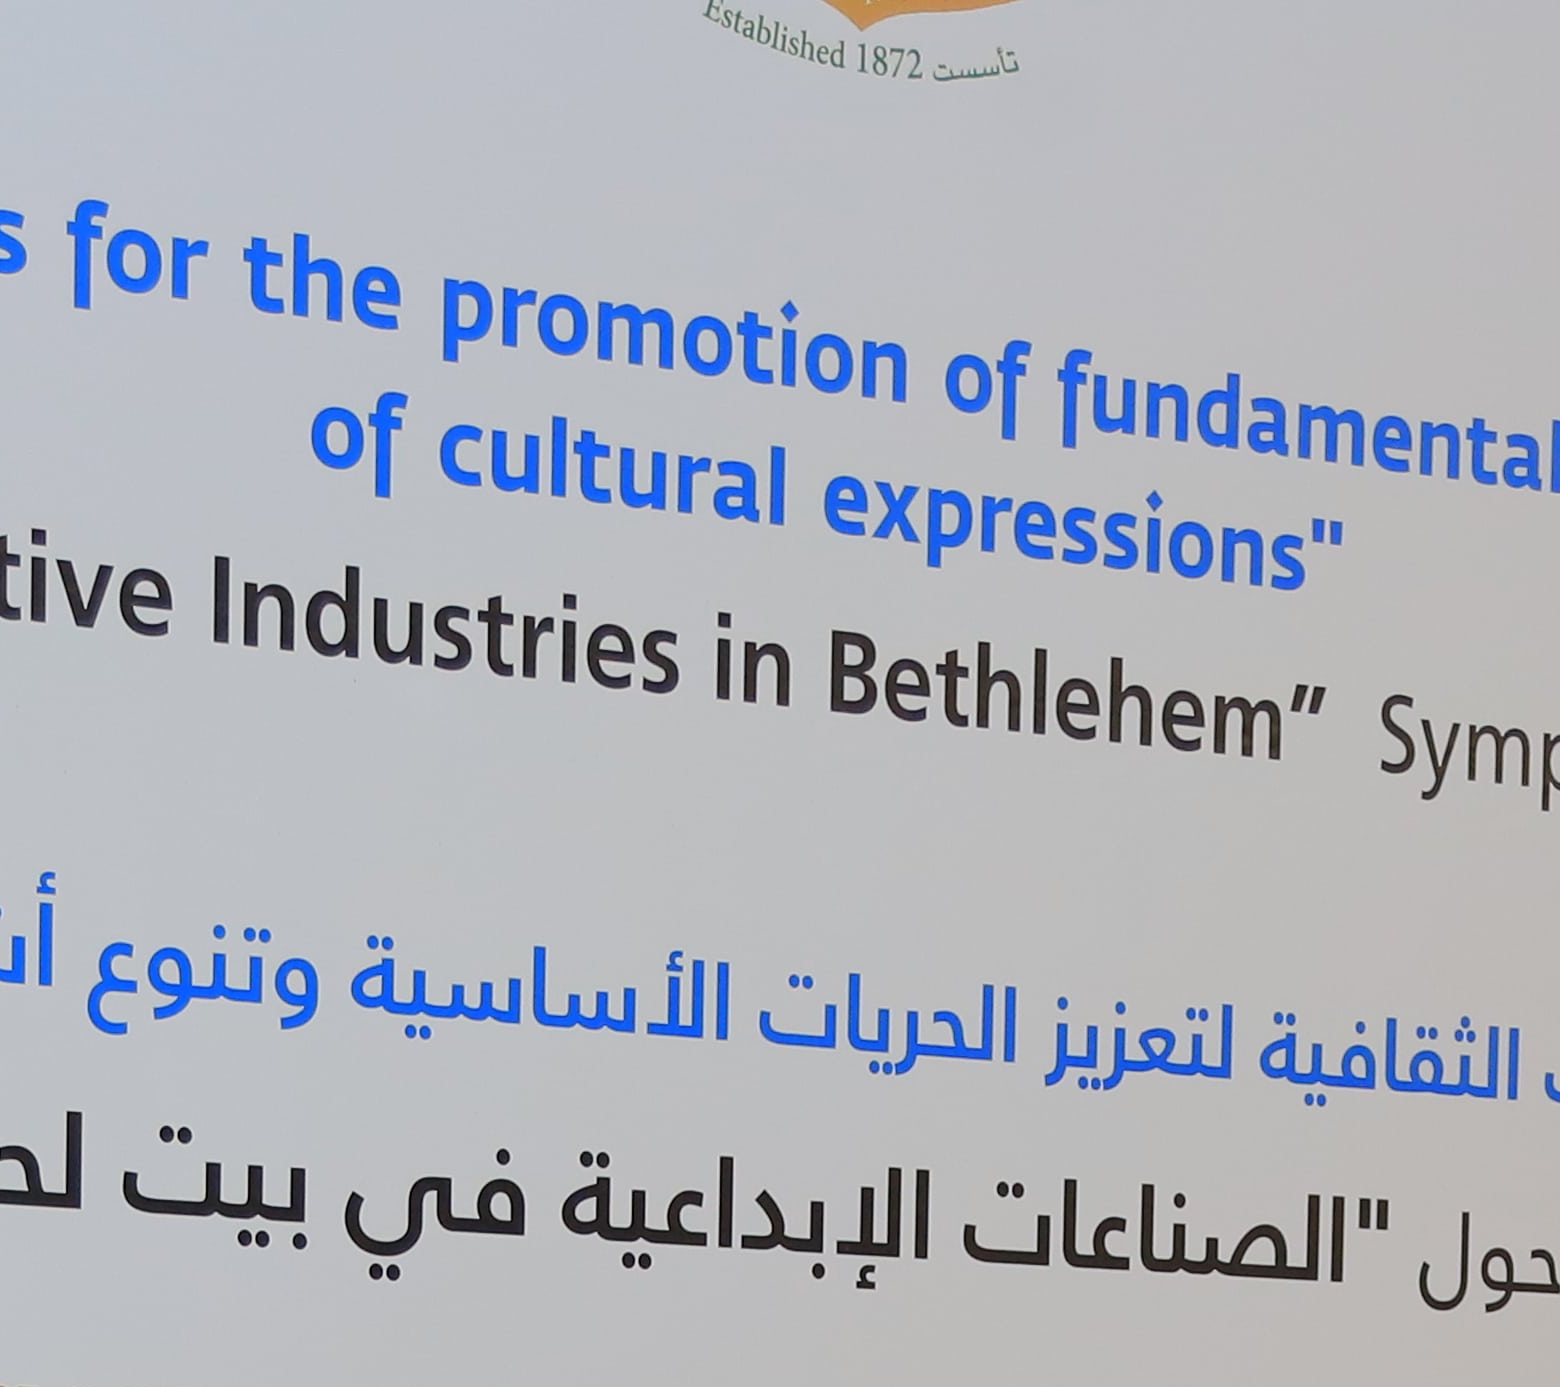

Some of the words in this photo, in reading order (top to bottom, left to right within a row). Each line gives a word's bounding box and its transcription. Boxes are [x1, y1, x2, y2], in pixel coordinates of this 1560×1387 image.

[702, 0, 845, 69] Established
[856, 43, 922, 79] 1872
[932, 47, 1020, 82] تأسست
[66, 198, 211, 310] for
[242, 231, 403, 331] the
[442, 276, 908, 403] promotion
[944, 338, 1033, 441] of
[310, 390, 409, 499] of
[439, 415, 787, 526] cultural
[823, 474, 1344, 591] expressions"
[213, 555, 679, 694] Industries
[716, 611, 790, 707] in
[86, 923, 320, 1036] وتنوع
[350, 934, 731, 1041] الأساسية
[759, 972, 1017, 1076] الحريات
[1044, 996, 1234, 1090] لتعزيز
[1259, 1011, 1520, 1107] الثقافية
[122, 1125, 308, 1250] بيت
[344, 1148, 526, 1282] في
[561, 1150, 930, 1290] الإبداعية
[963, 1178, 1389, 1283] "الصناعات
[1418, 1211, 1560, 1313] حول
